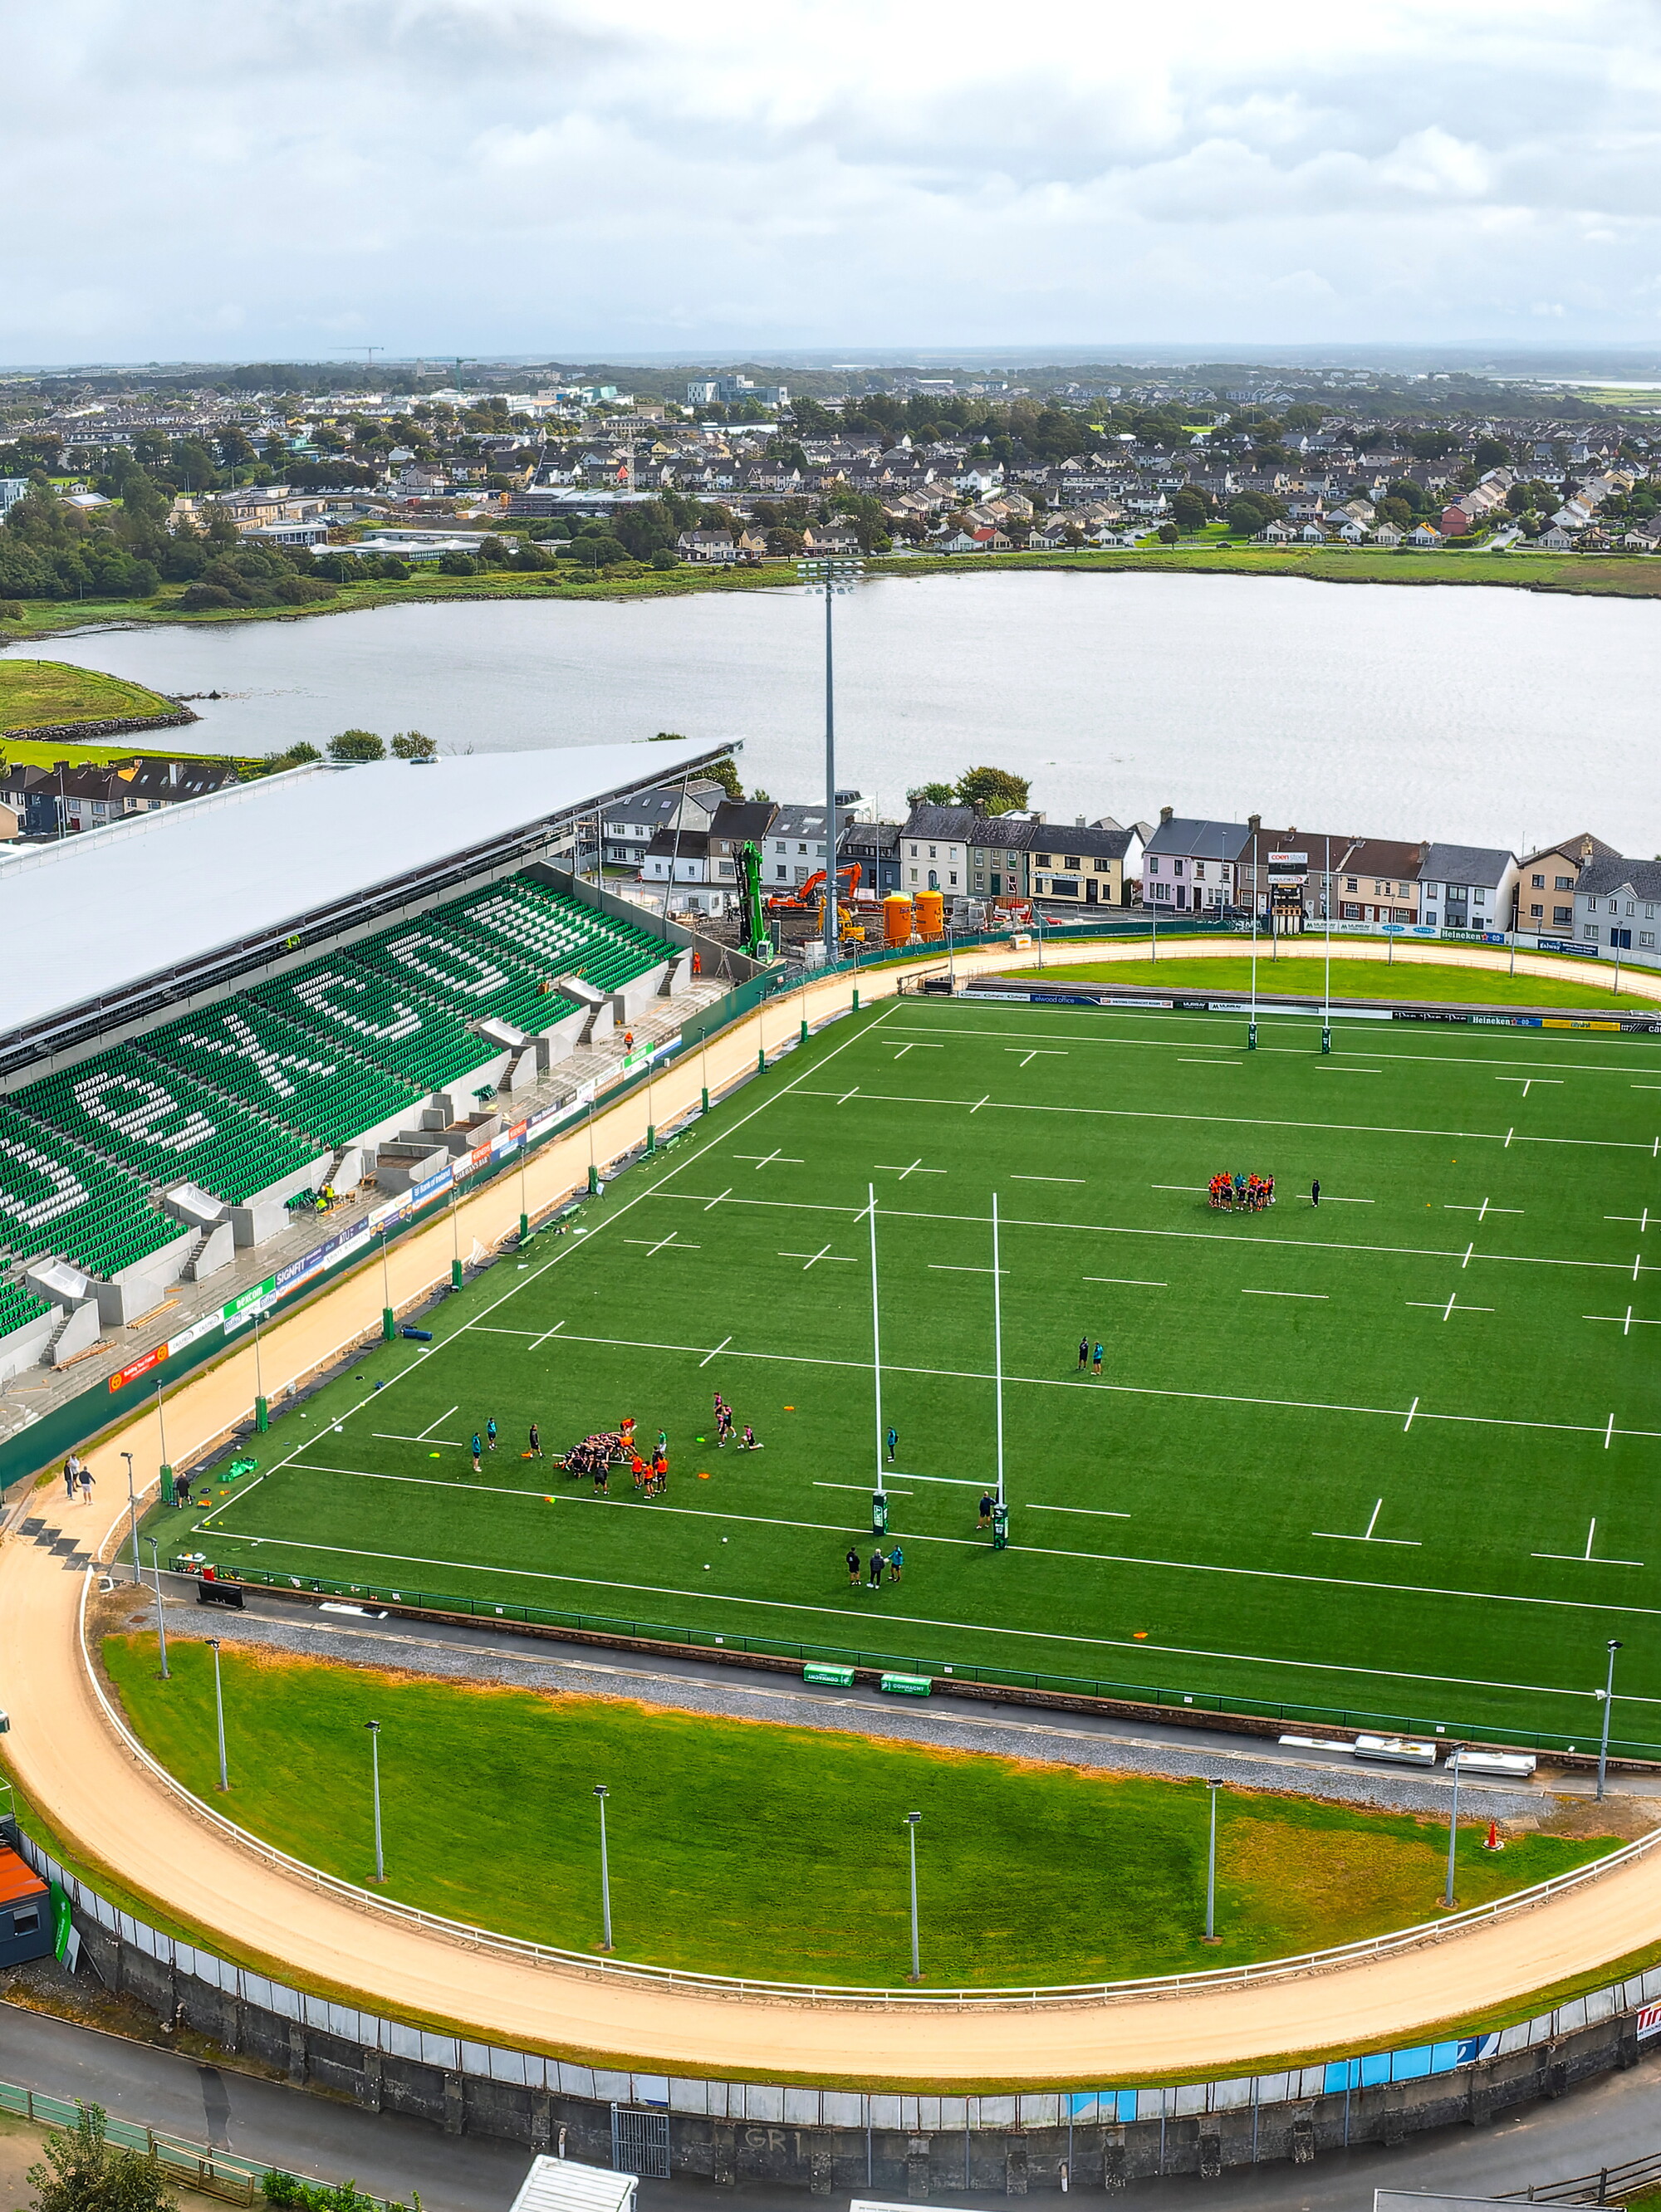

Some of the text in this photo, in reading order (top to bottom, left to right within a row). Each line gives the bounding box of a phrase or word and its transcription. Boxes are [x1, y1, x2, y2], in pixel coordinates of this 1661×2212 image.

[1442, 930, 1482, 941] Heineken
[1540, 942, 1561, 950] galway
[1472, 1016, 1511, 1025] Heineken
[419, 1182, 431, 1193] Bank
[434, 1168, 451, 1185] Ireland
[339, 1230, 350, 1245] ATU
[276, 1258, 306, 1286] SIGNFIT
[261, 1291, 276, 1306] coffey
[226, 1313, 241, 1329] coffey
[173, 1333, 192, 1349] CAULFIELD
[124, 1365, 138, 1377] Building
[137, 1360, 145, 1371] Your
[144, 1354, 155, 1367] Future
[807, 1674, 839, 1683] CONNACHT
[893, 1683, 924, 1692] CONNACHT
